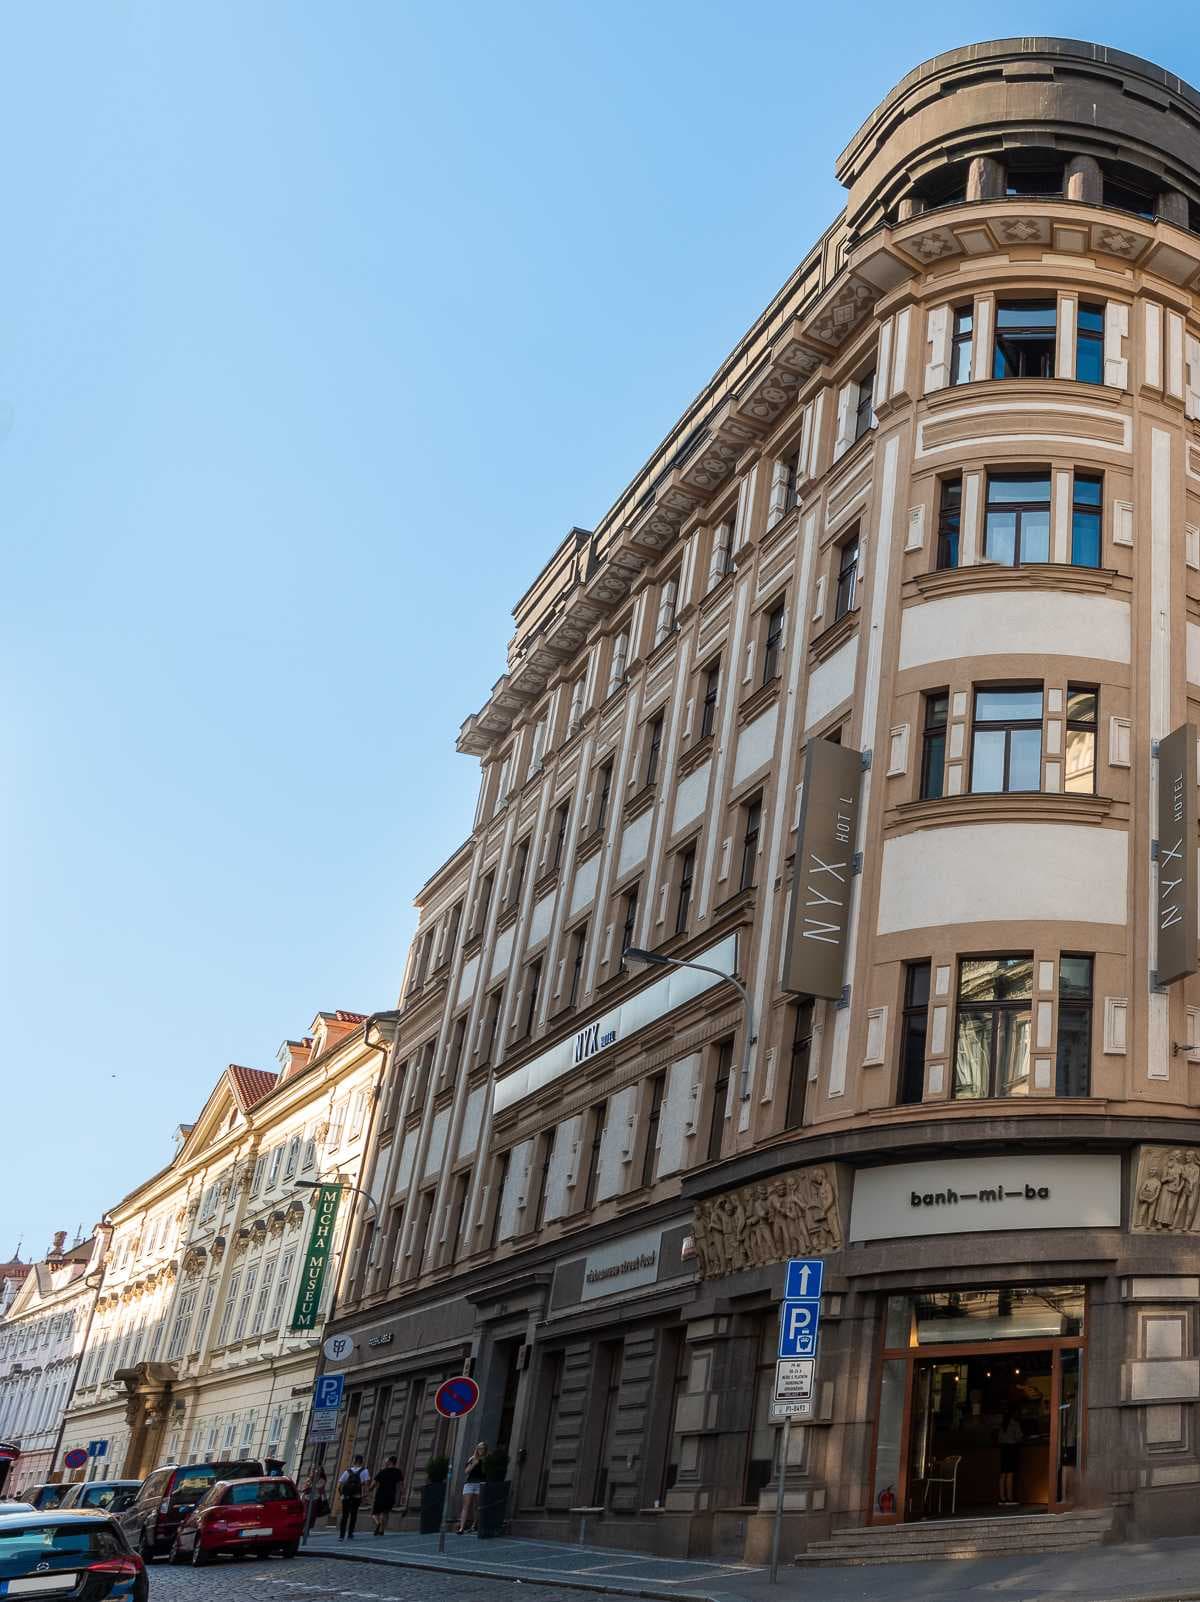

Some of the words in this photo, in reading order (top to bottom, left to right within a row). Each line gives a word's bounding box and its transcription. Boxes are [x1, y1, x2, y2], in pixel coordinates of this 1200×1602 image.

[802, 853, 847, 945] NYX
[835, 796, 853, 843] HOTL
[1161, 838, 1183, 929] NYX
[1174, 771, 1184, 822] HOTEL
[575, 1023, 600, 1063] NYX
[314, 1191, 337, 1248] MUCHA
[297, 1256, 324, 1325] MUSEUM
[789, 1308, 811, 1339] P
[321, 1380, 338, 1399] P
